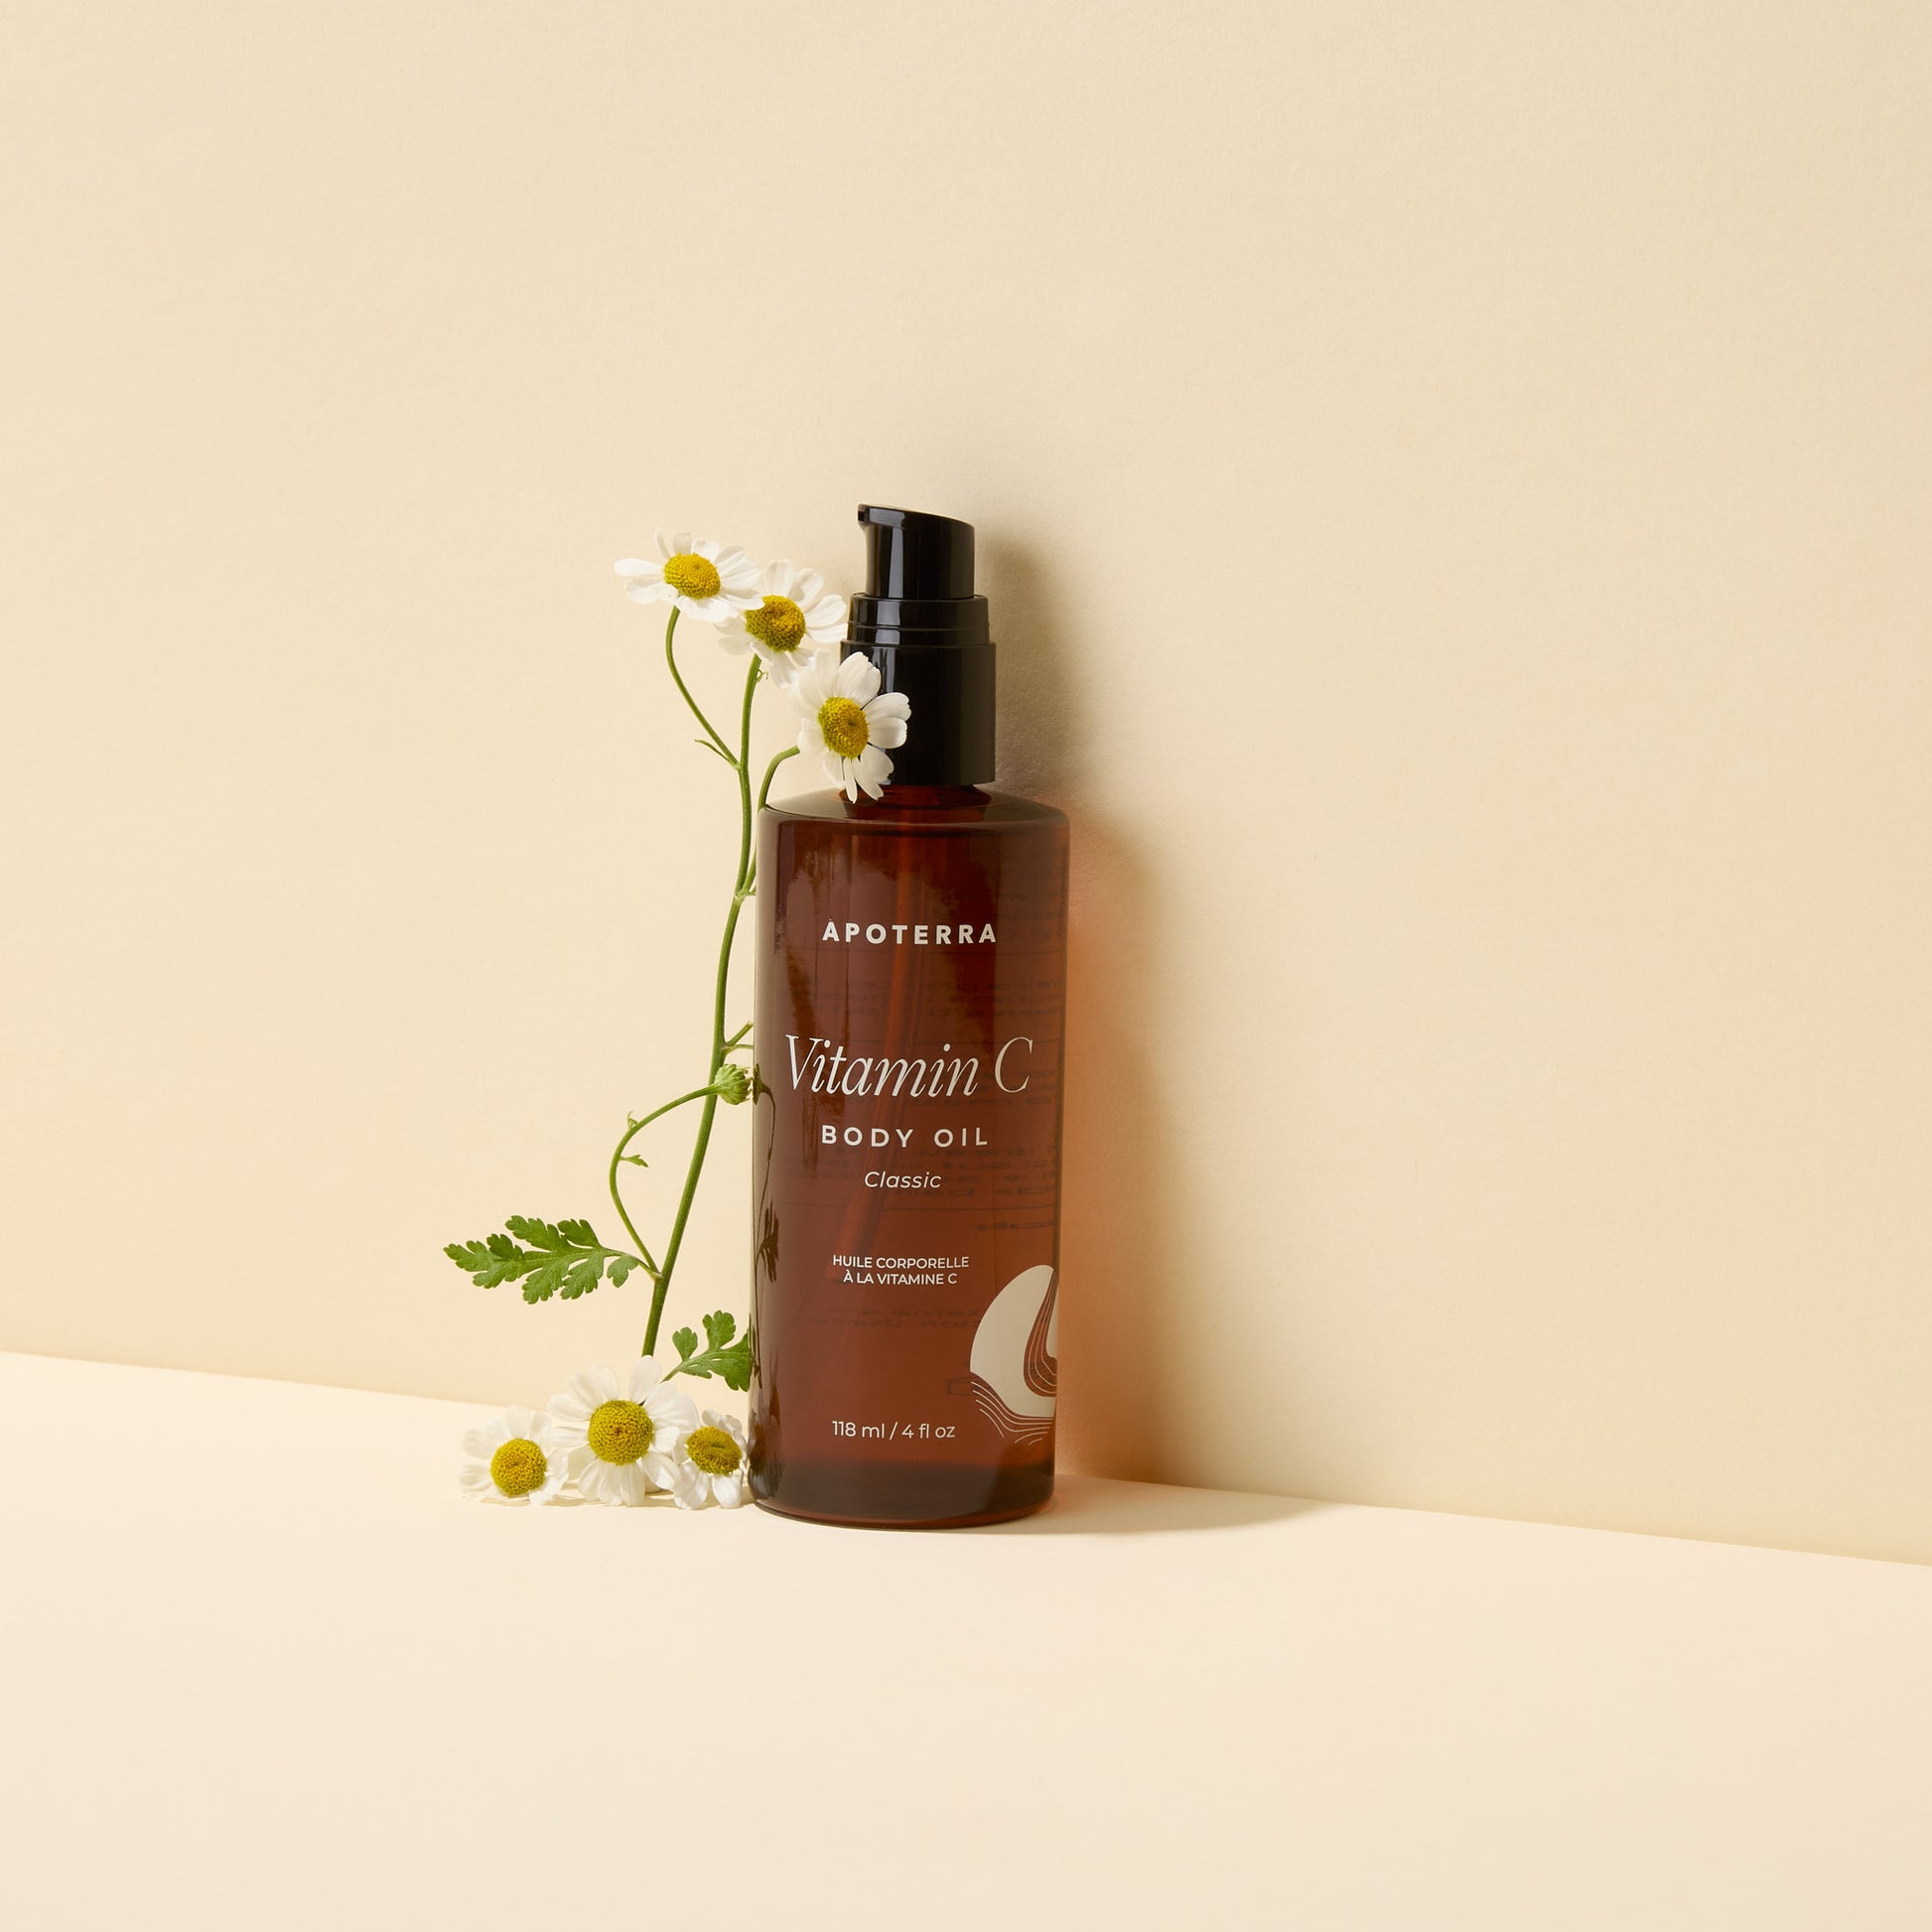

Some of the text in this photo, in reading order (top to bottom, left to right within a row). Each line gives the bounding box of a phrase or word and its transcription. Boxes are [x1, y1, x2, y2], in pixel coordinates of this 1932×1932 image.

[822, 920, 996, 944] APOTERRA
[785, 1035, 1033, 1097] Vitamin C
[821, 1125, 988, 1148] BODY OIL
[865, 1171, 942, 1188] Classic
[832, 1255, 969, 1269] HUILE CORPORELLE
[843, 1269, 957, 1285] À LA VITAMINE C
[832, 1421, 857, 1437] 118
[862, 1424, 885, 1438] ml
[901, 1424, 914, 1439] 4
[918, 1423, 930, 1439] fl
[934, 1426, 956, 1439] oz
